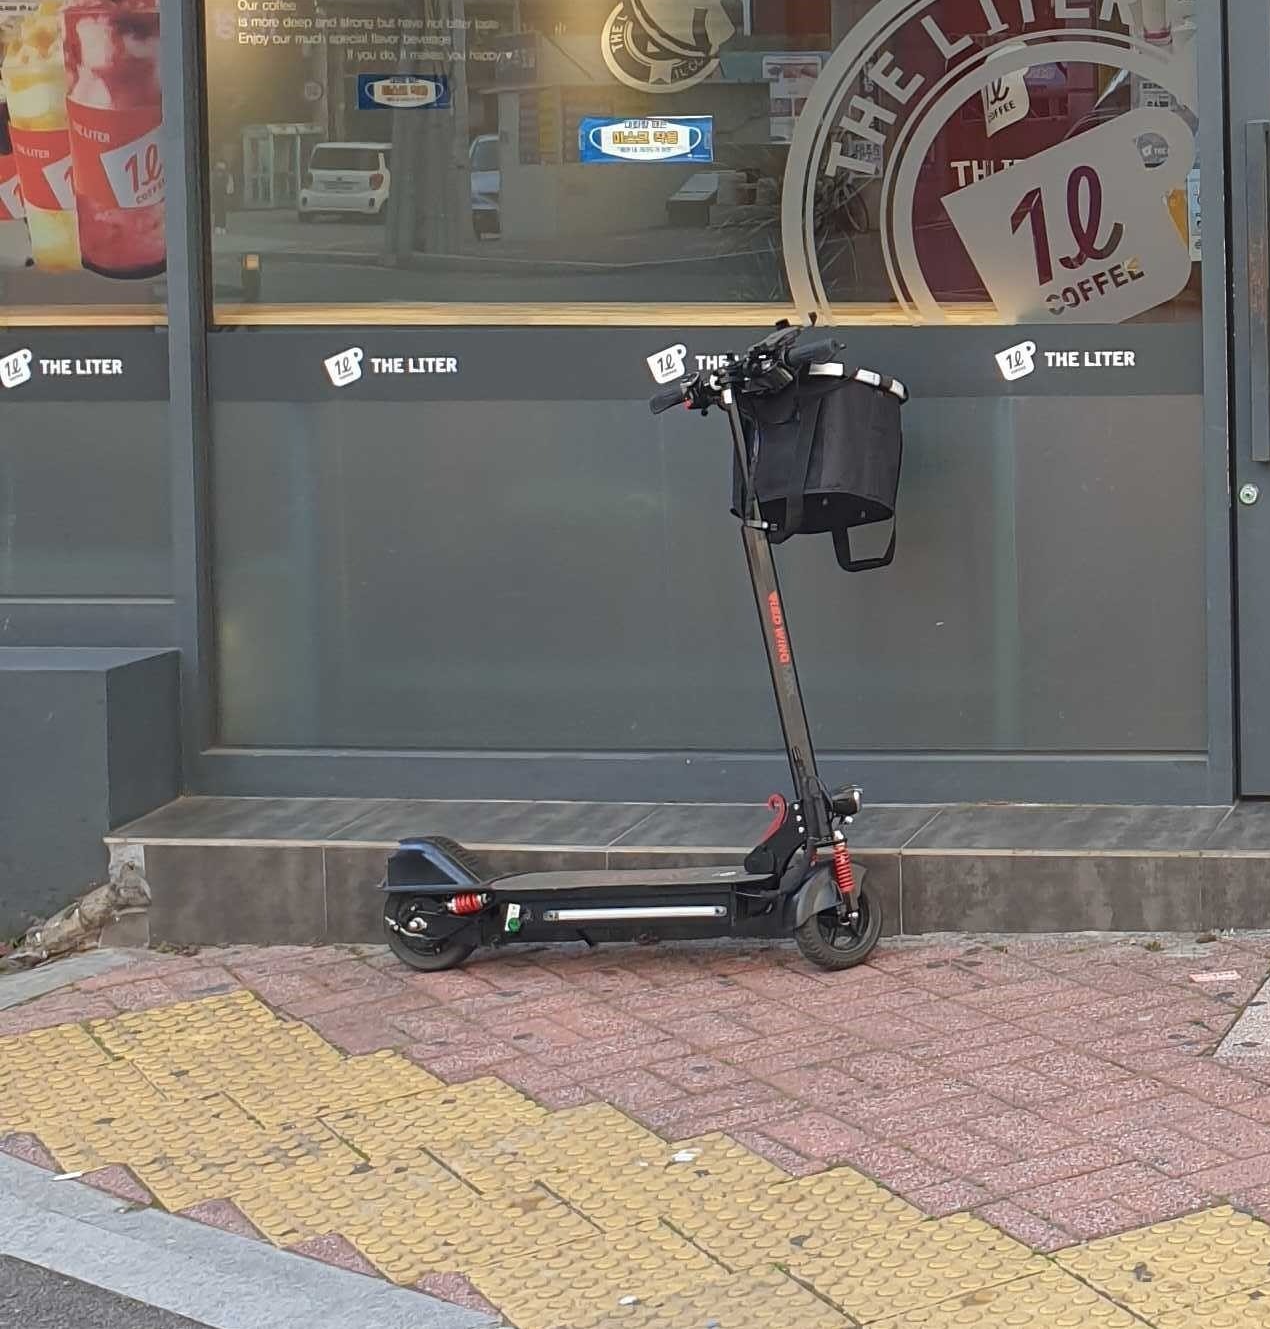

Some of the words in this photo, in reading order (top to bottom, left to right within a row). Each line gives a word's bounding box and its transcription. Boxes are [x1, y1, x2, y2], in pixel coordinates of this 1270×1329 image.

[825, 51, 926, 179] THE
[1045, 256, 1144, 315] COFFEE
[40, 358, 71, 374] THE
[76, 358, 123, 375] LITER
[371, 357, 404, 373] THE
[408, 357, 457, 373] LITER
[1044, 351, 1080, 367] THE
[1084, 350, 1136, 367] LITER
